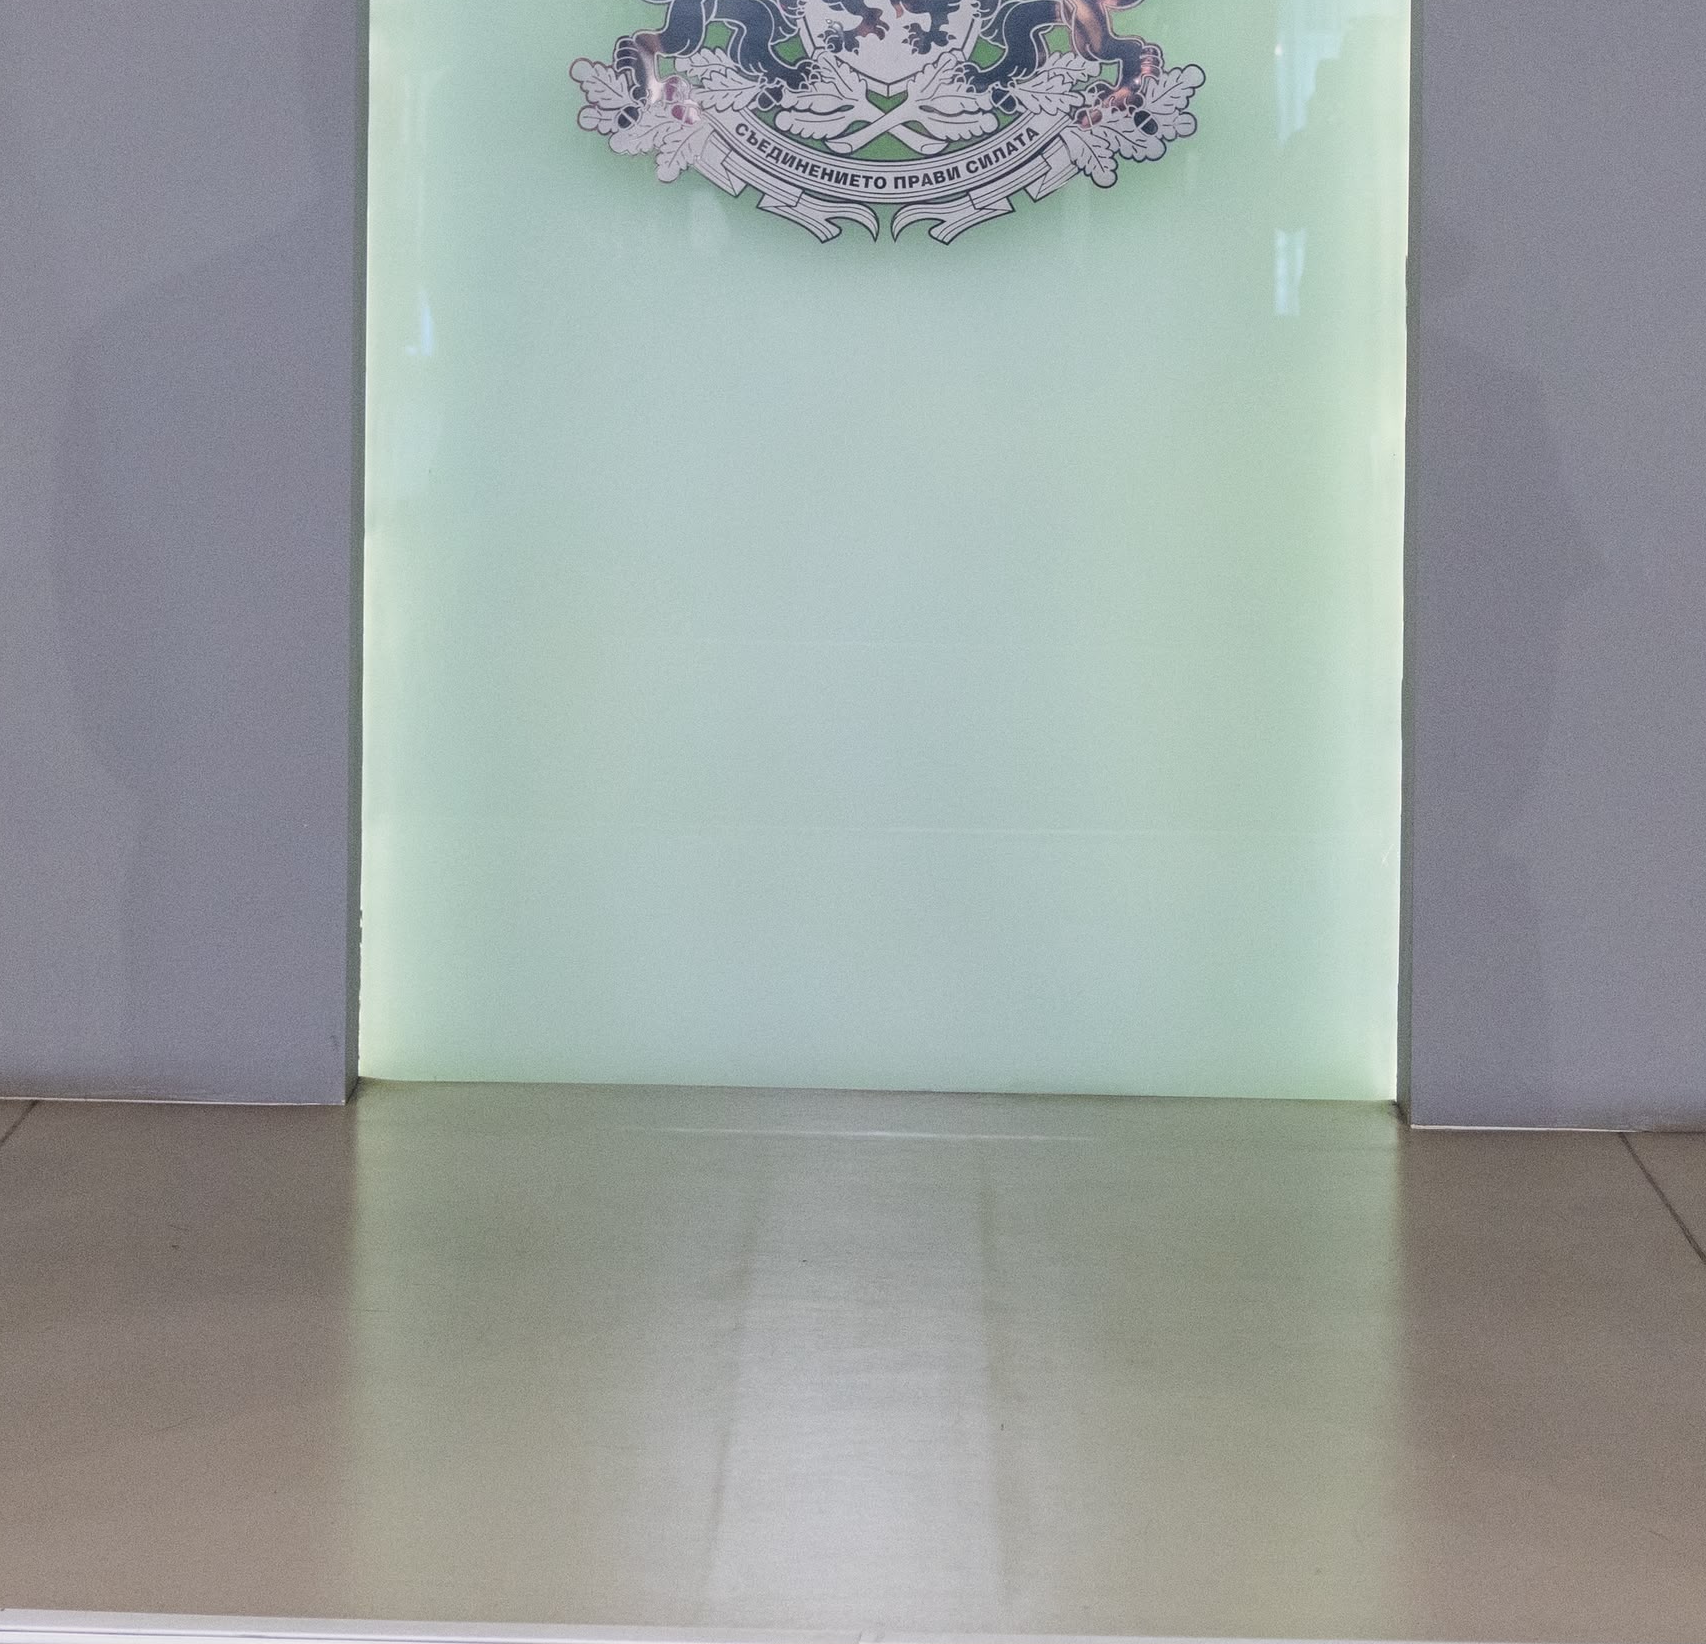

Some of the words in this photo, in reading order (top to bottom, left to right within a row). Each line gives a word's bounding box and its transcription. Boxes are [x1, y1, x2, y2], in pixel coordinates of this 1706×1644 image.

[734, 122, 887, 190] СЪЕДИНЕНИЕТО
[893, 165, 961, 190] ПРАВИ
[965, 125, 1040, 175] СИЛАТА
